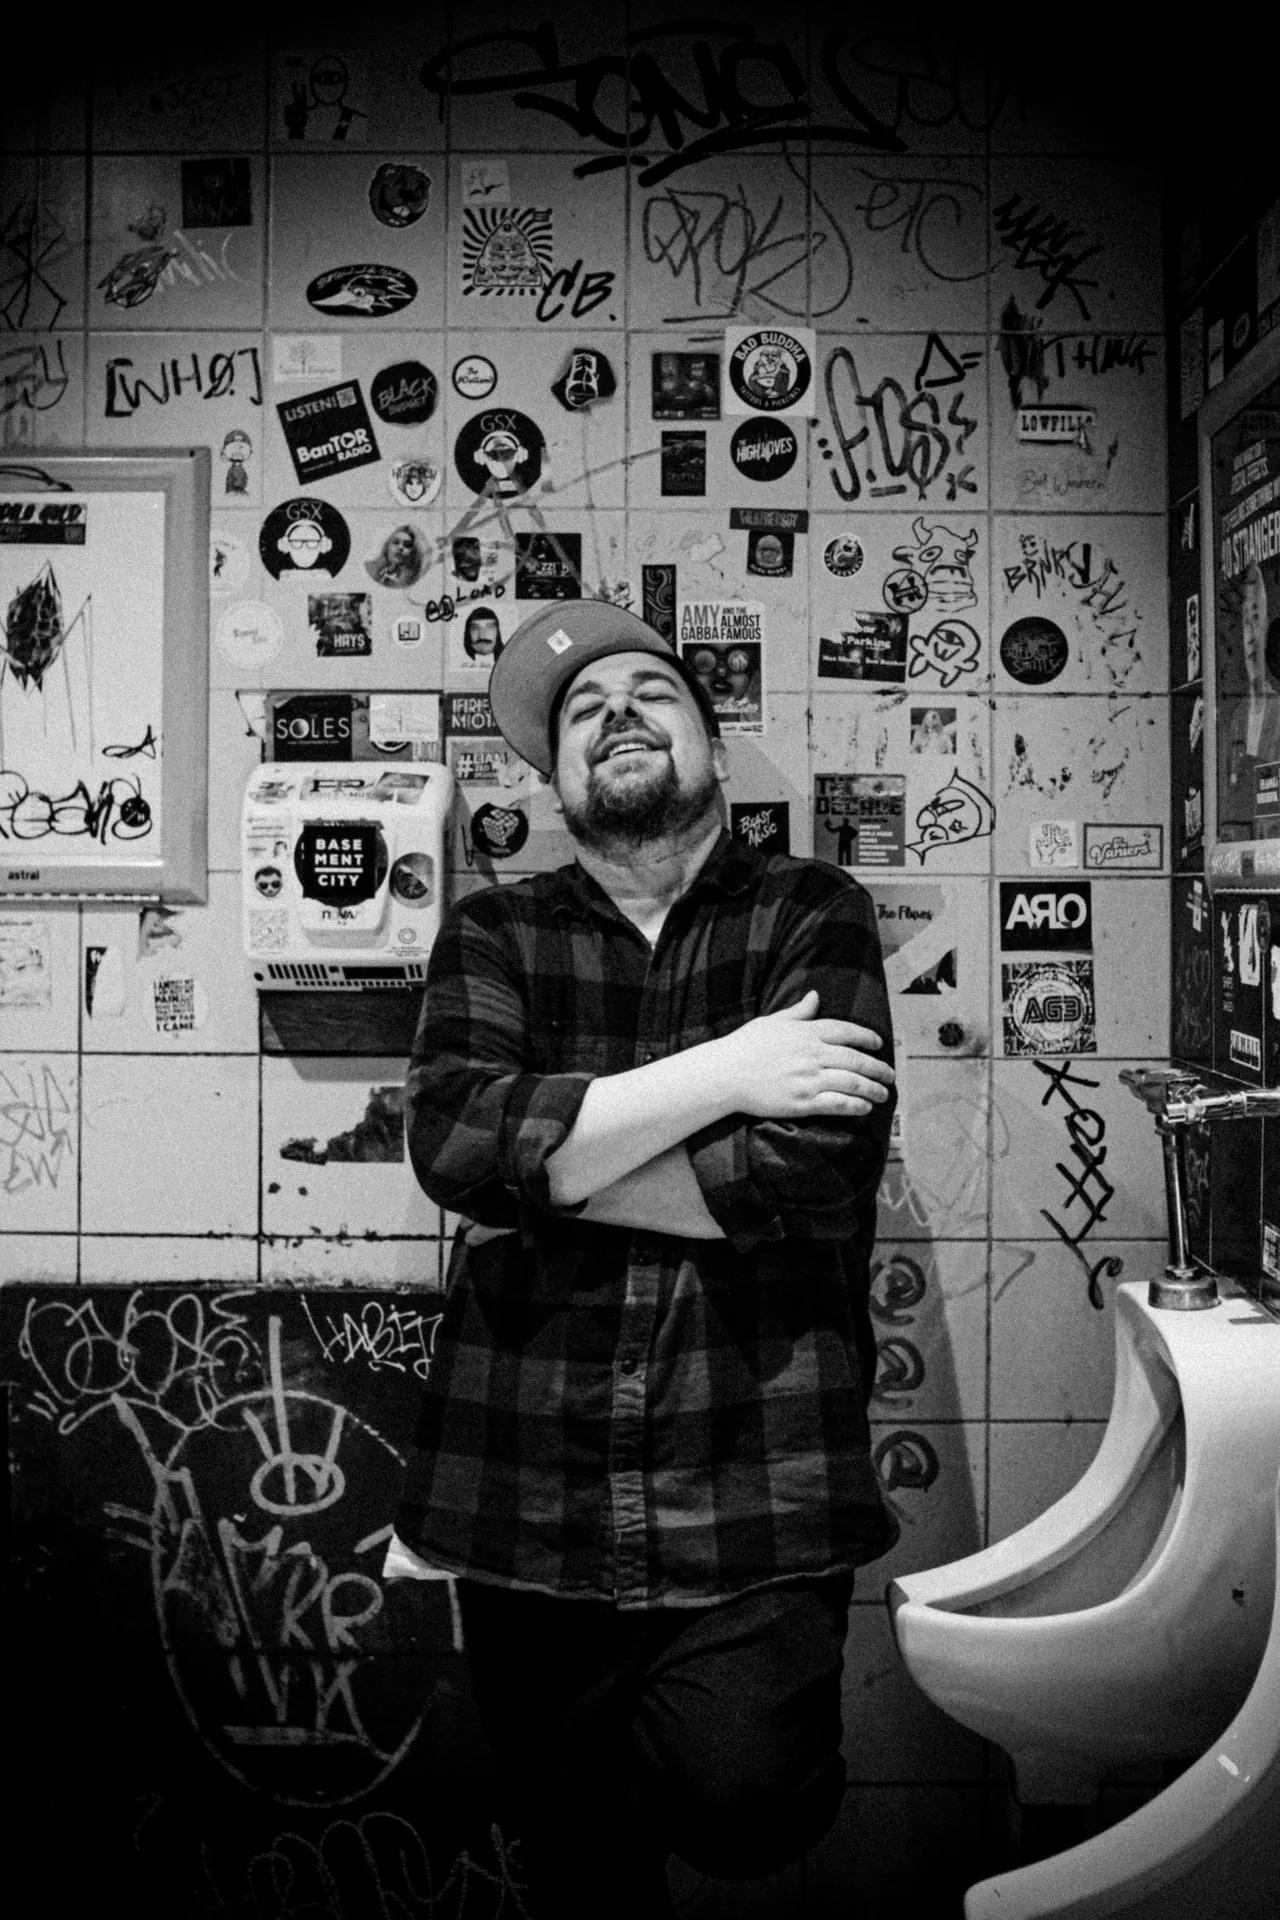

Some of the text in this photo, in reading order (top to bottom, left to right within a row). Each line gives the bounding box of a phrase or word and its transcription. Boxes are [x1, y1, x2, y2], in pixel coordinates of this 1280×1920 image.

[734, 332, 807, 362] BAD BUDDHA
[377, 376, 435, 412] BLACK
[480, 413, 517, 432] GSX
[297, 428, 370, 464] BanTOR
[337, 444, 373, 462] RADIO
[286, 502, 324, 521] GSX
[681, 604, 721, 626] AMY
[722, 606, 747, 615] AND THE
[720, 614, 761, 627] ALMOST
[681, 626, 762, 641] GABBA FAMOUS
[276, 716, 350, 739] SOLES
[315, 838, 363, 850] BASE
[315, 854, 364, 866] MENT
[317, 874, 360, 887] CITY
